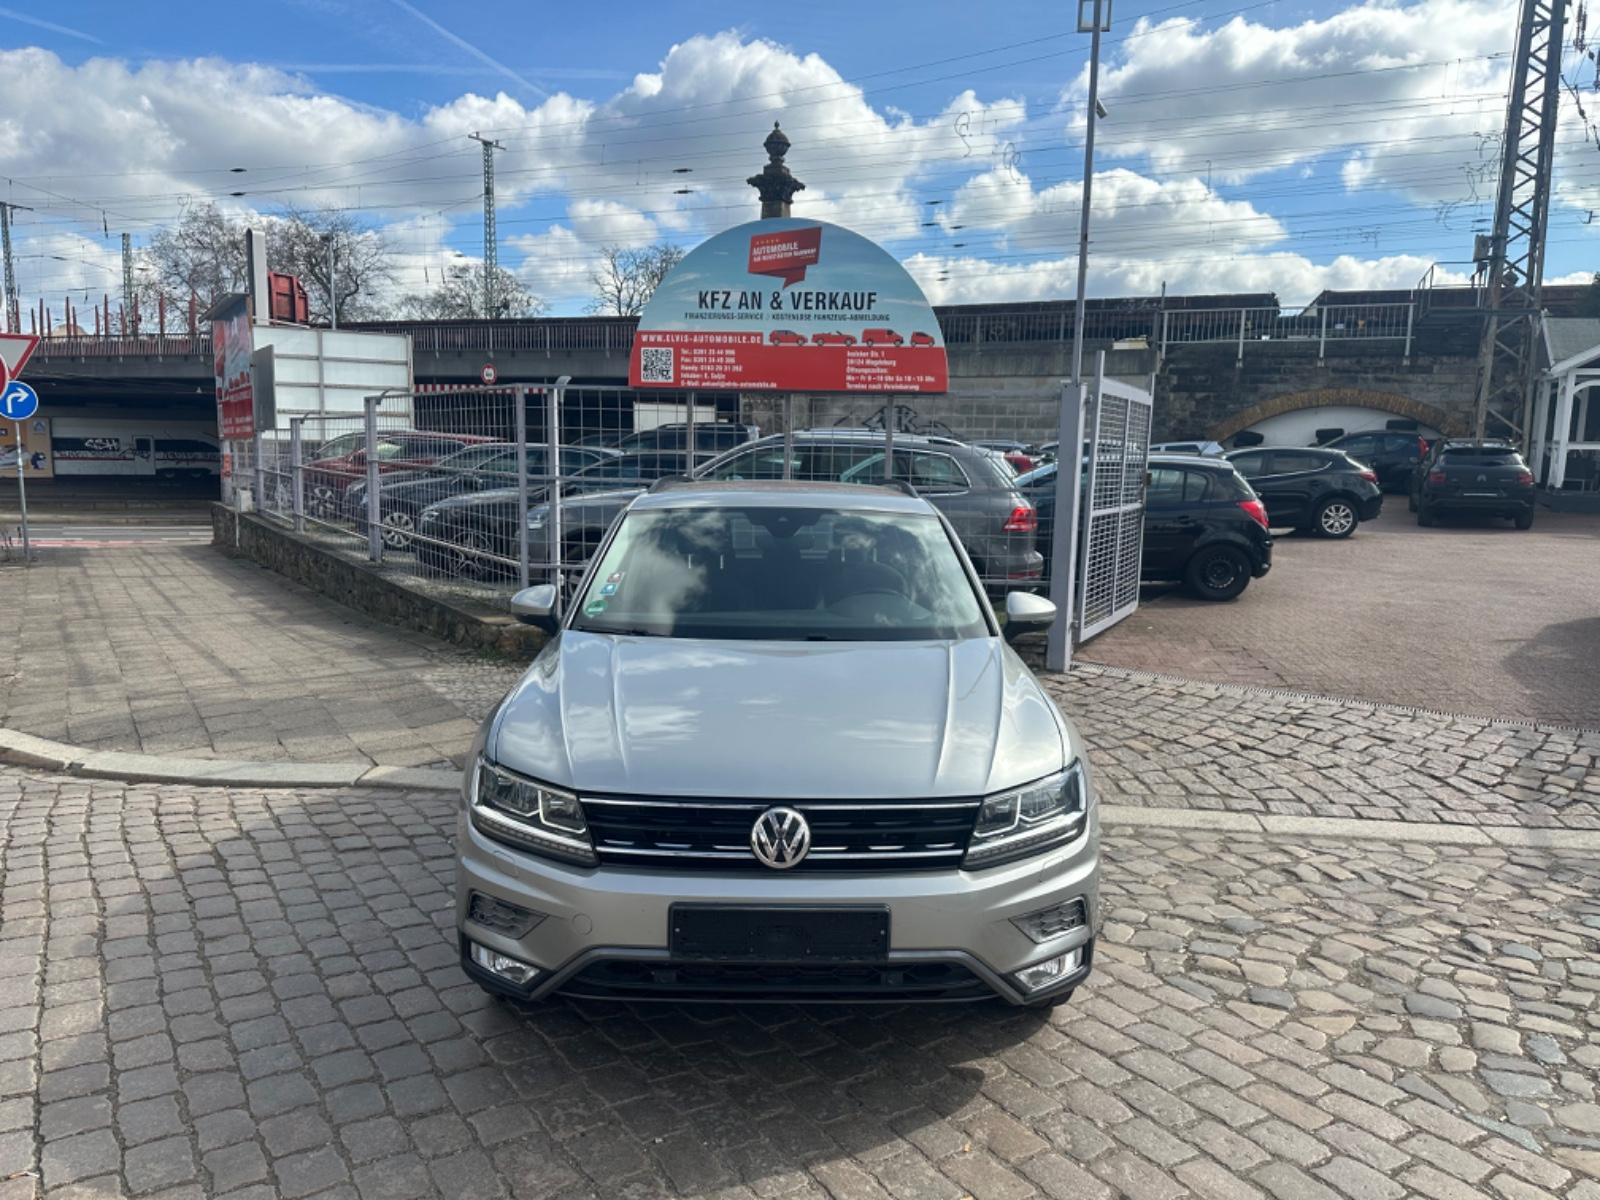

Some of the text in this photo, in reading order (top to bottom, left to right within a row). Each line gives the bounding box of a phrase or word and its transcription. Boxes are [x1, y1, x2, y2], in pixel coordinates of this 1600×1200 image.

[752, 241, 799, 256] AUTOMOBILE
[698, 290, 878, 311] KFZ AN & VERKAUF
[772, 313, 811, 321] KOSTENLOSE
[641, 334, 761, 344] WWW.ELVIS-AUTOMOBILE.DE
